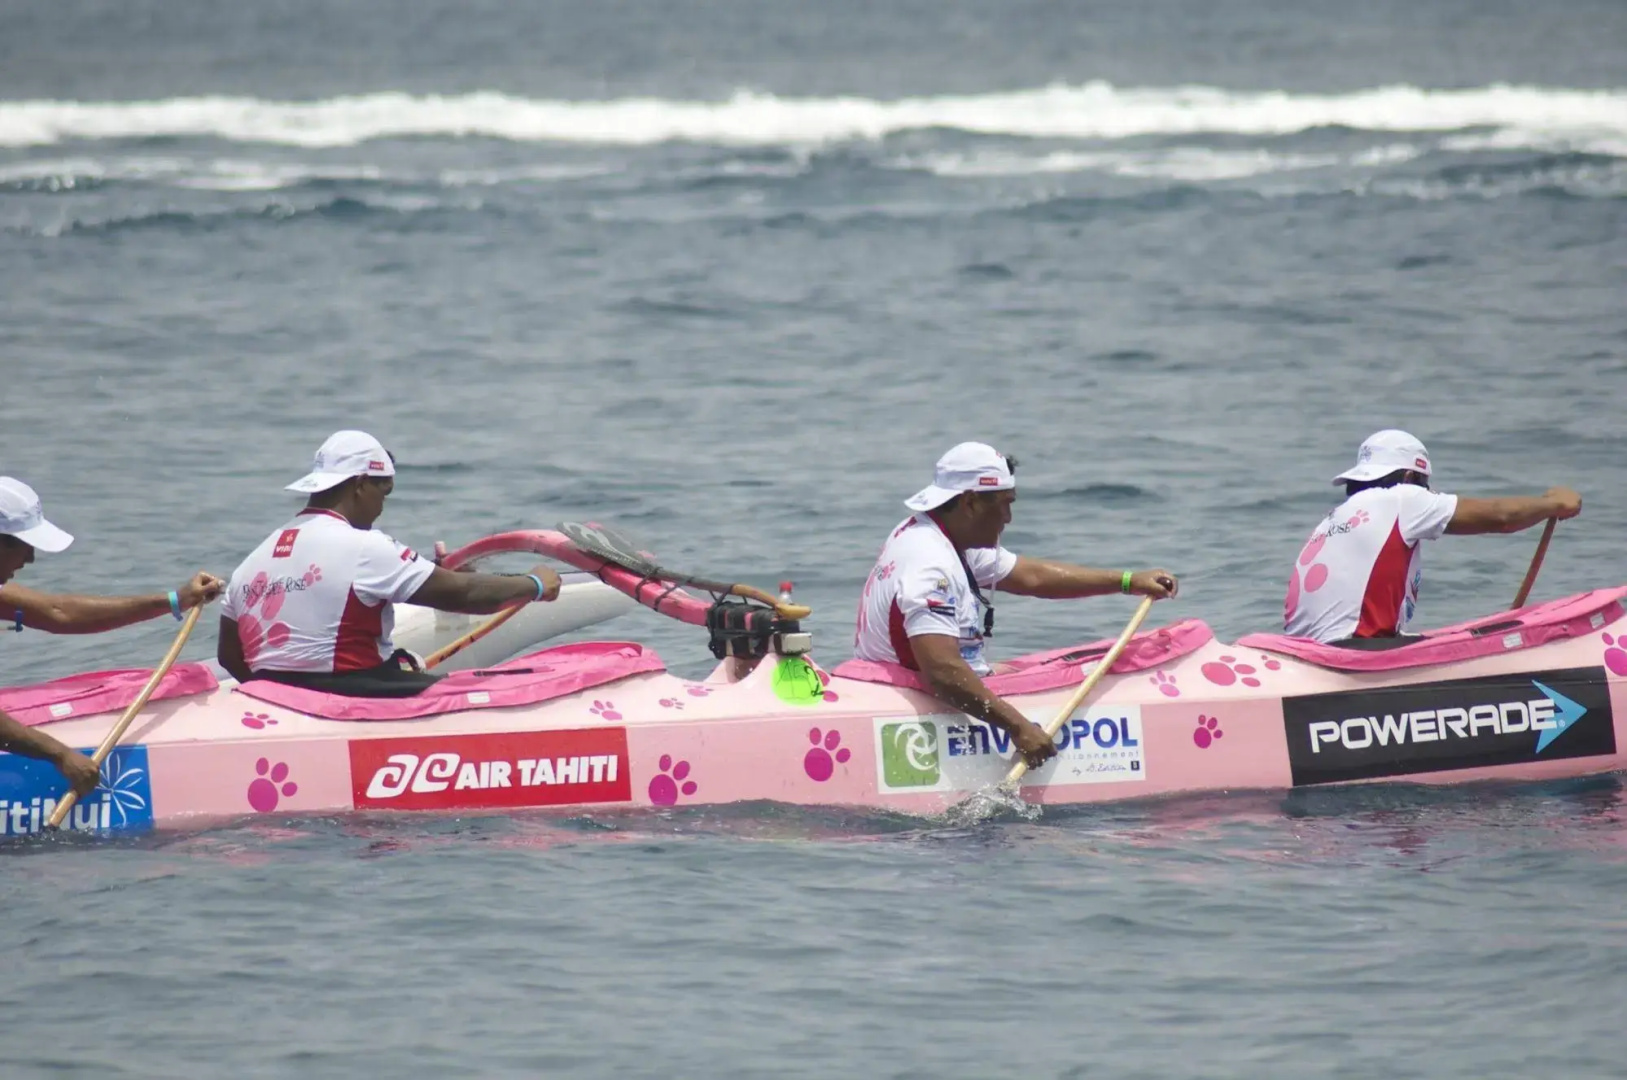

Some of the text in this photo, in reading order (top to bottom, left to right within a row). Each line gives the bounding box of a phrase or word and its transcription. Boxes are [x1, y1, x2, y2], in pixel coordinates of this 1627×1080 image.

[1309, 698, 1557, 753] POWERADE
[454, 754, 618, 790] AIR TAHITI
